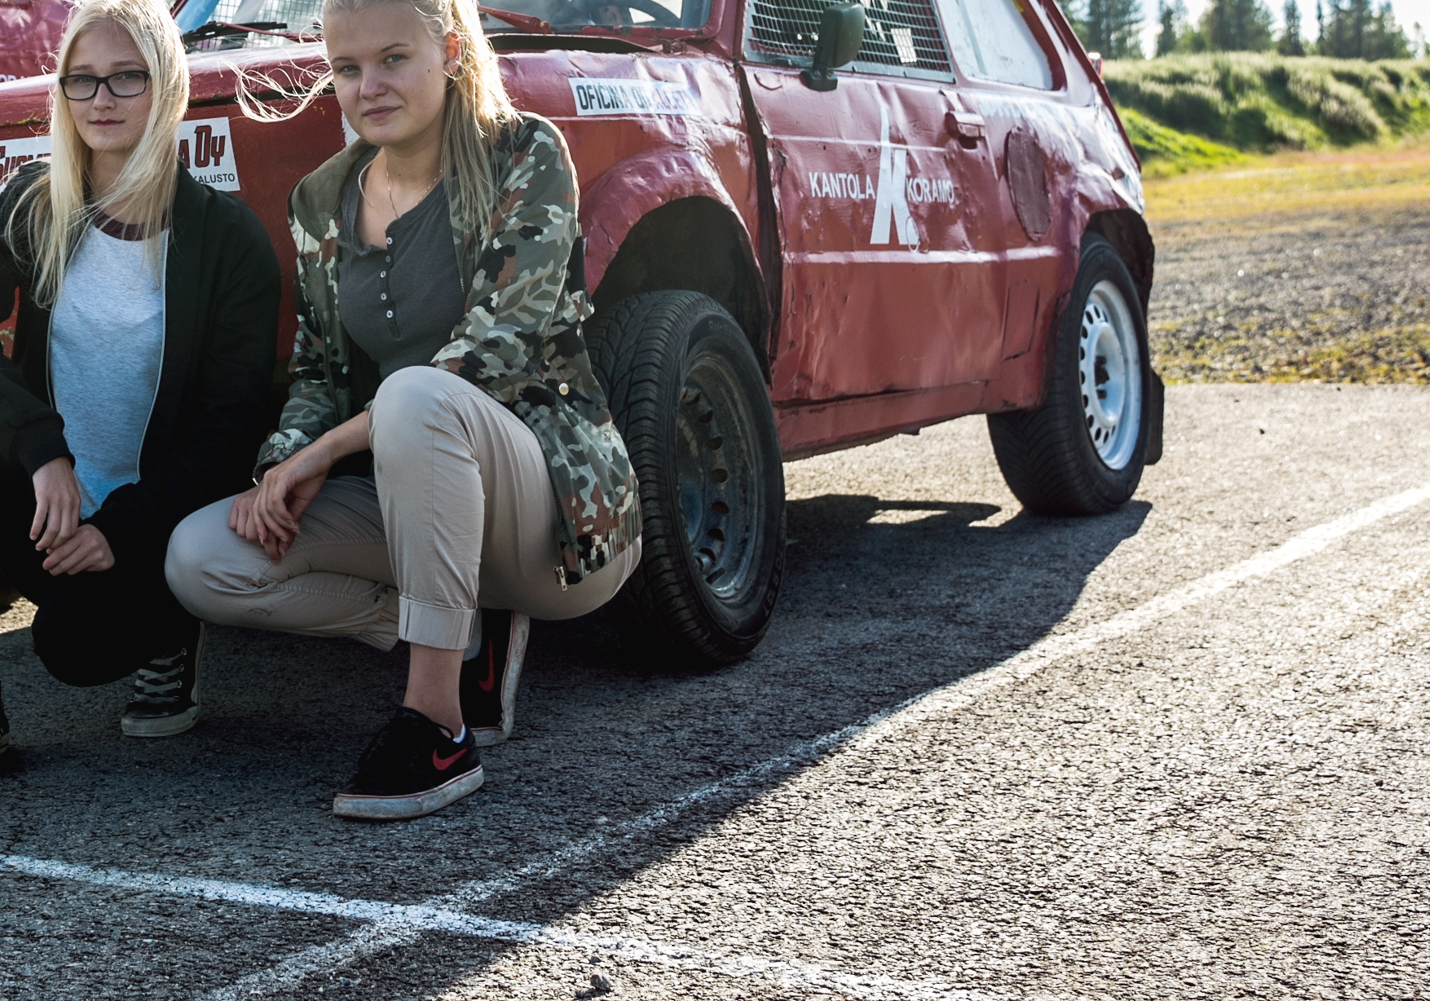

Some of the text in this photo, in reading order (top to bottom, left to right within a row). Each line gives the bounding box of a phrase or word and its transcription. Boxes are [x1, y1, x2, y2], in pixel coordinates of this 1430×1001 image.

[194, 124, 226, 168] OY
[808, 171, 876, 200] KANTOLA
[906, 177, 956, 204] KORAMO
